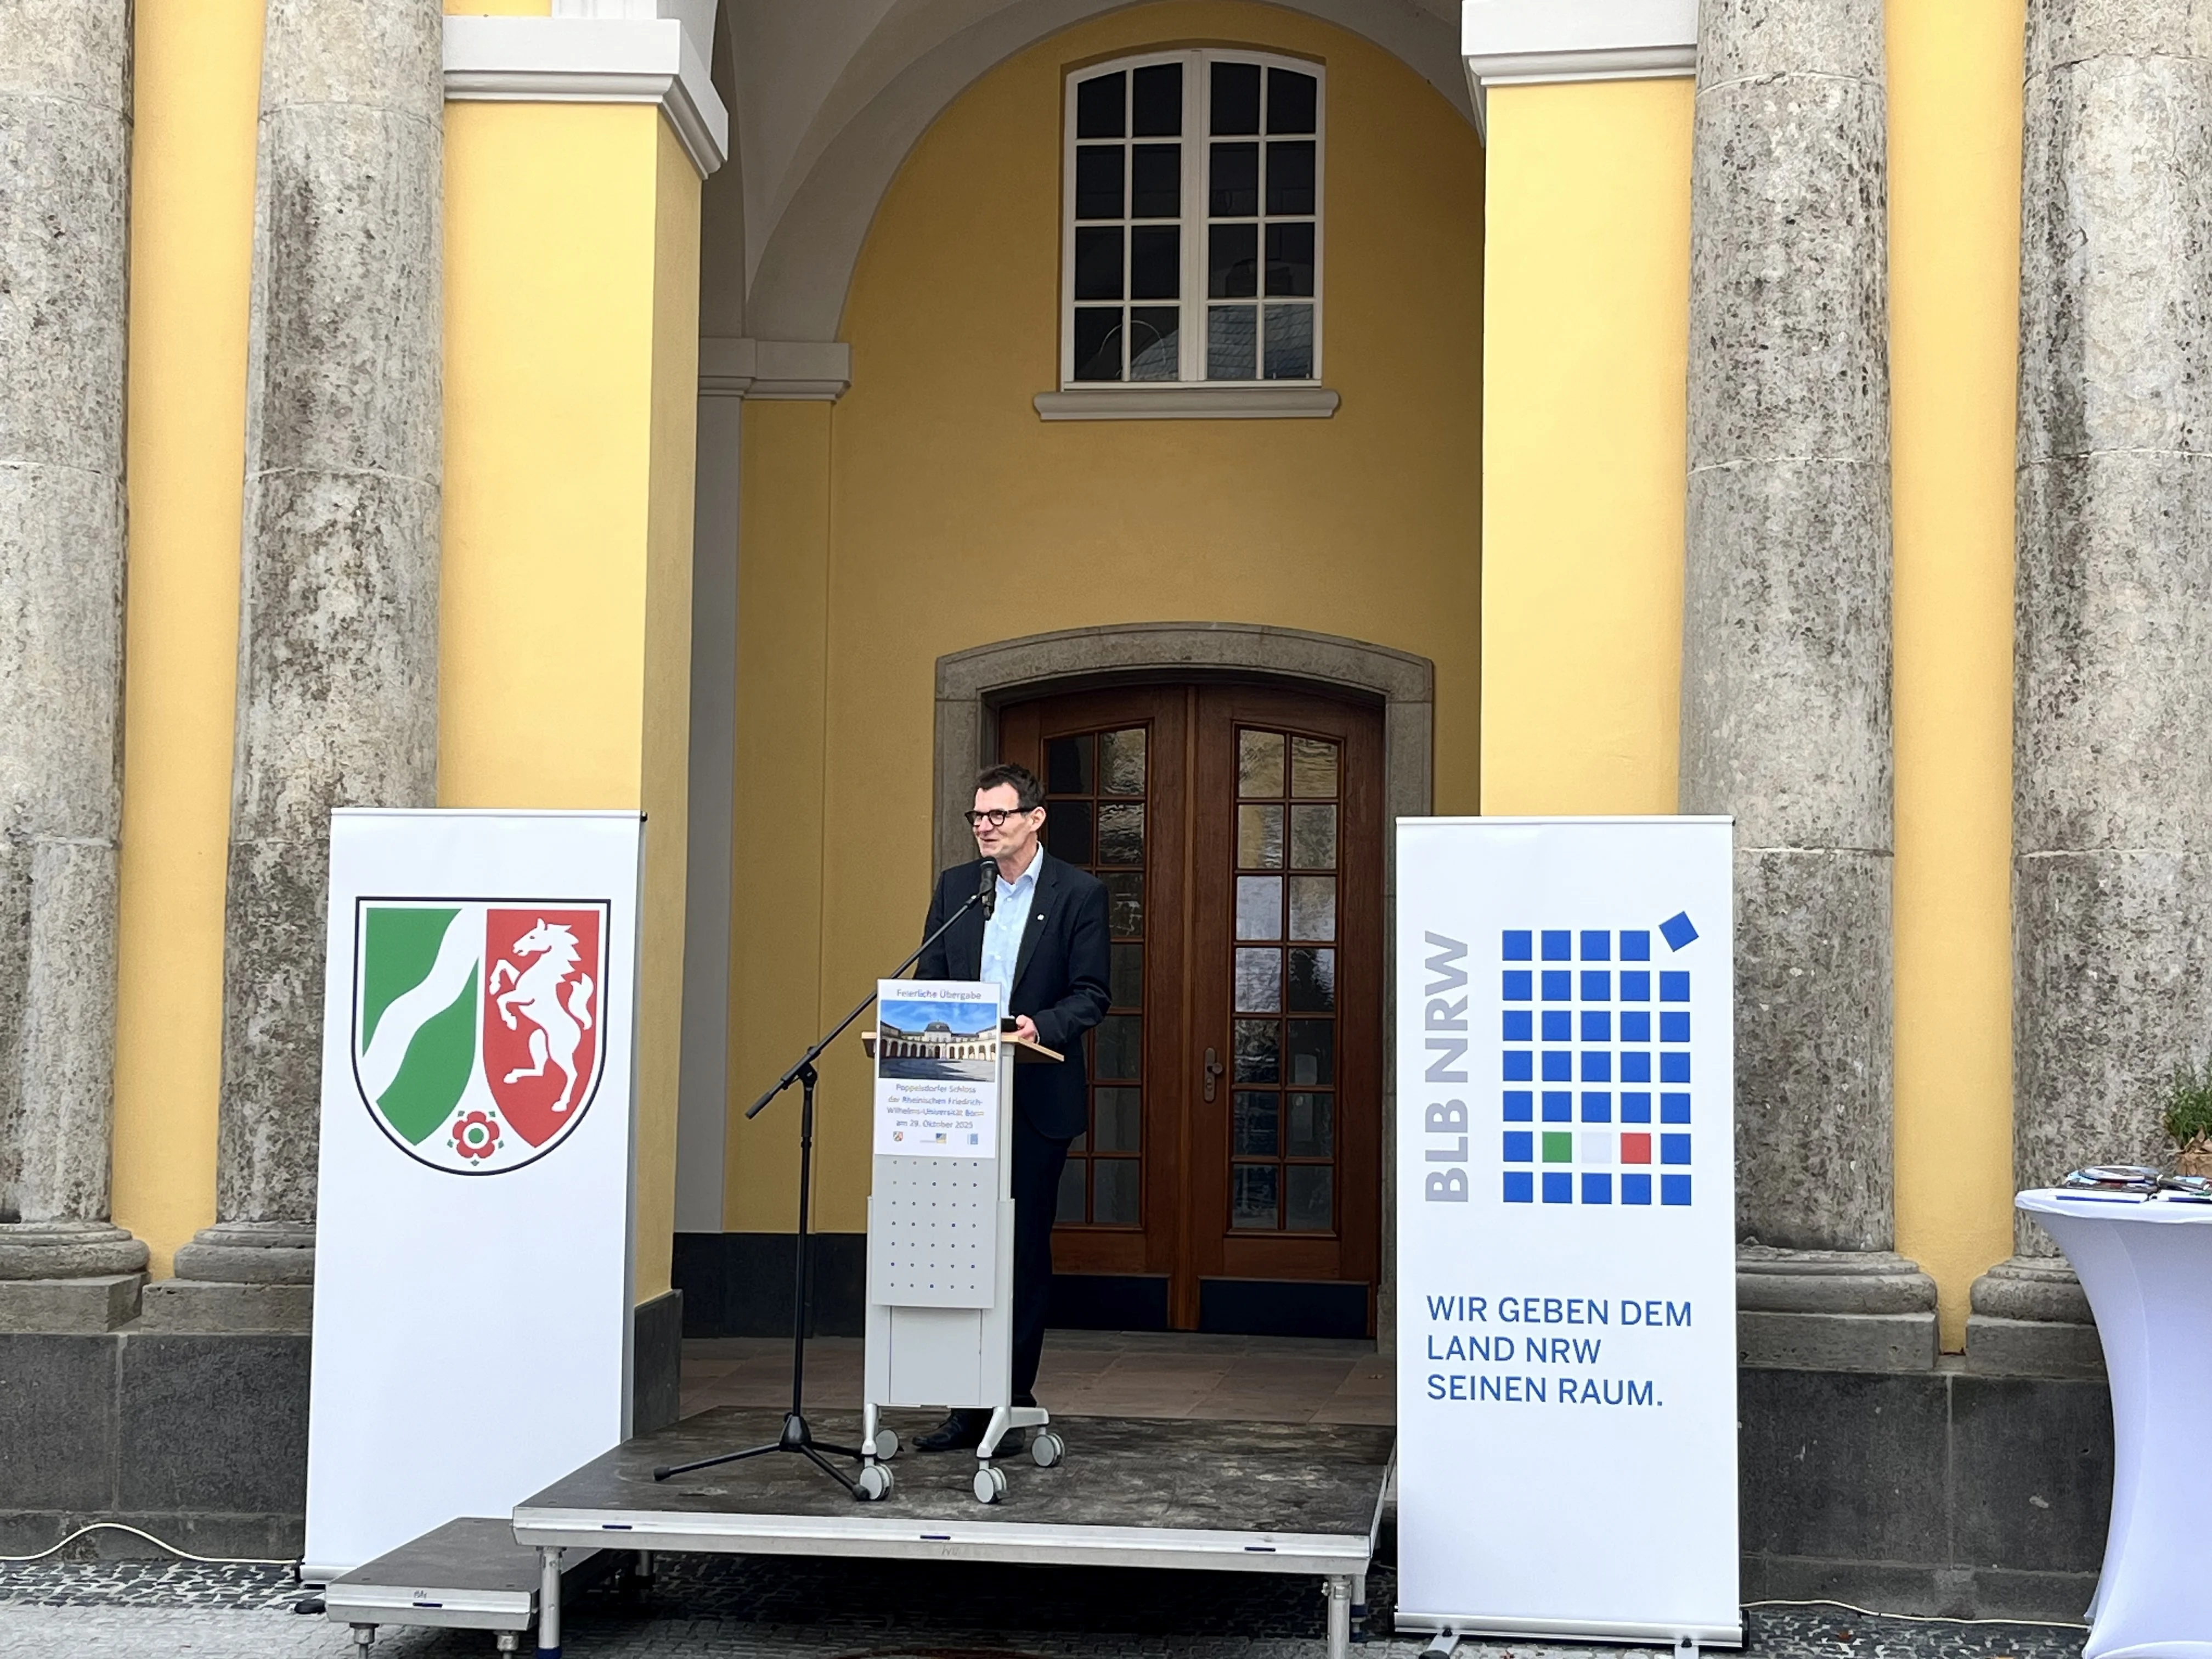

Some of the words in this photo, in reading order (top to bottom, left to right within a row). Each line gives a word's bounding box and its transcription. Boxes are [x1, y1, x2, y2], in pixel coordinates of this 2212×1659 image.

[939, 989, 982, 1000] Übergabe
[1424, 930, 1468, 1084] NRW
[1425, 1099, 1469, 1203] BLB
[1427, 1295, 1487, 1322] WIR
[1498, 1297, 1608, 1325] GEBEN
[1621, 1300, 1691, 1327] DEM
[1428, 1335, 1515, 1361] LAND
[1526, 1337, 1601, 1364] NRW
[1427, 1374, 1546, 1402] SEINEN
[1559, 1378, 1663, 1407] RAUM.
